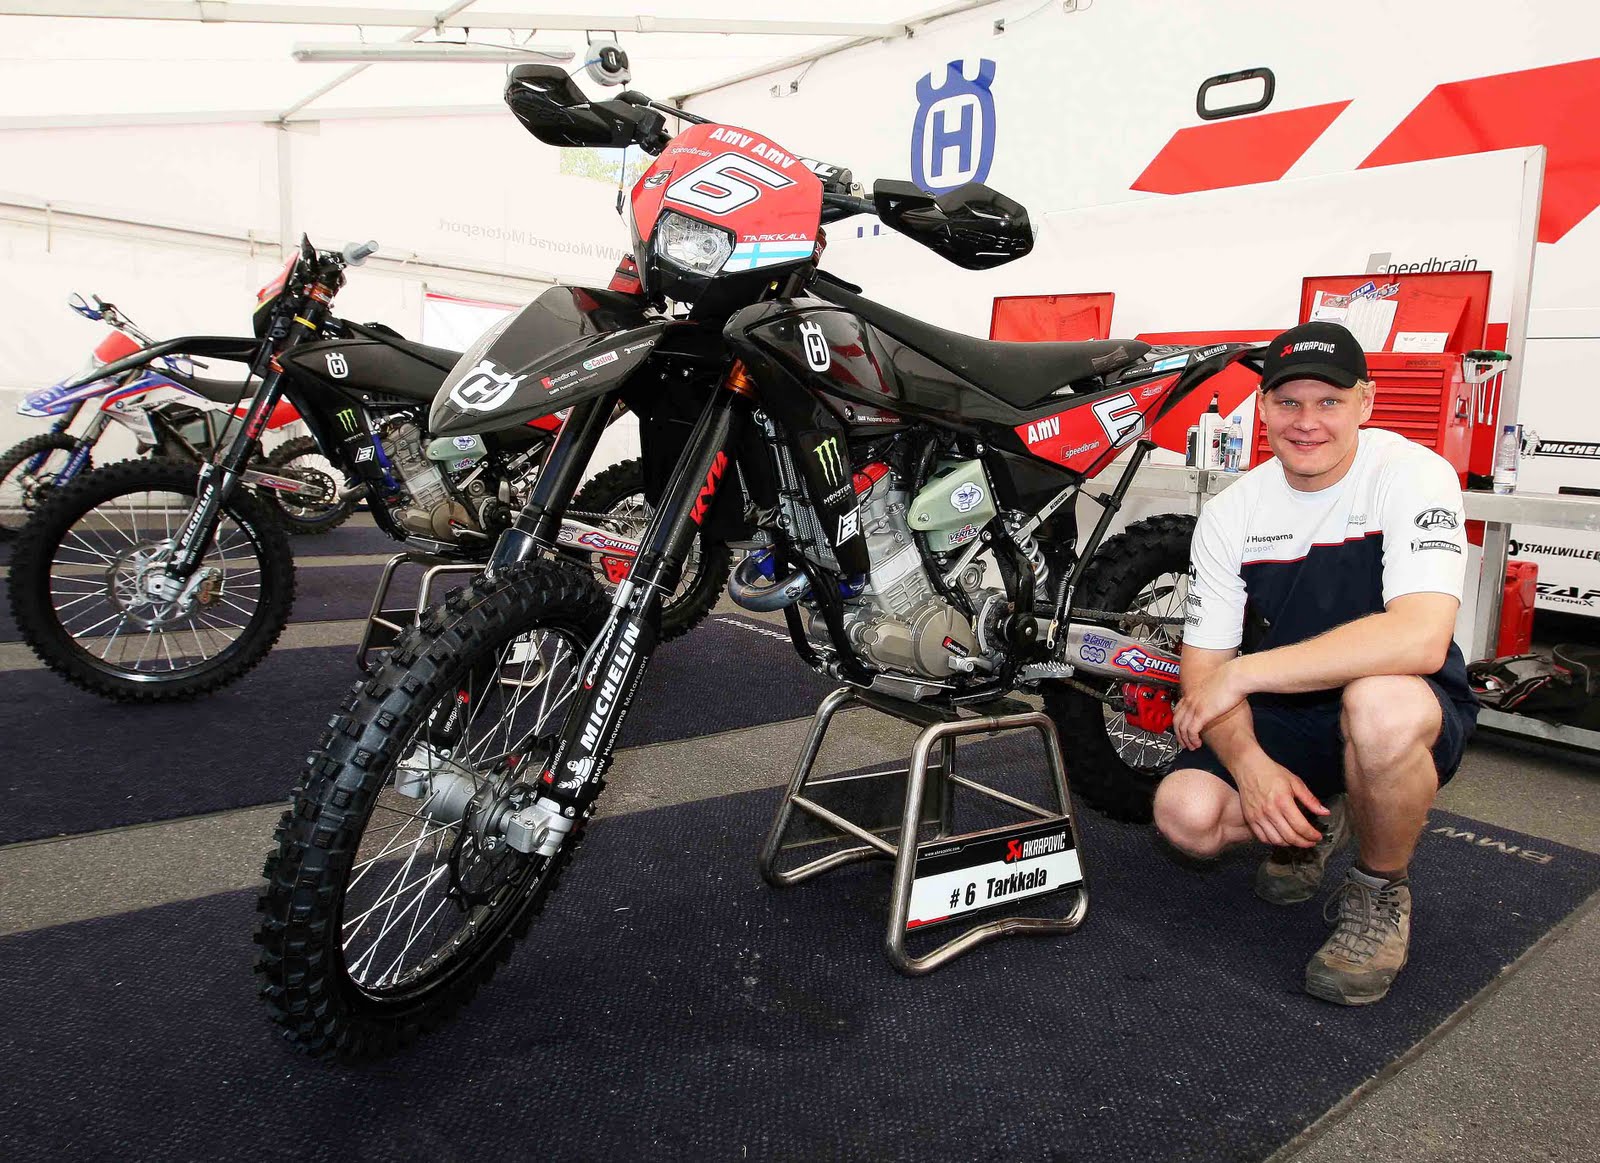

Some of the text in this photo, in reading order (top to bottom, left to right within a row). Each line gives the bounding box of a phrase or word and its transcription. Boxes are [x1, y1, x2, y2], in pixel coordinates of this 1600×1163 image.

[672, 146, 712, 157] speedbrain
[664, 152, 798, 216] 6
[743, 232, 808, 242] TARKKALA
[591, 353, 615, 368] Castrol
[547, 369, 580, 386] speedbrain
[1065, 439, 1100, 458] speedbrain
[181, 484, 215, 547] MICHELIN
[950, 527, 979, 542] VERTEX
[1252, 533, 1294, 543] Husqvarna
[1524, 544, 1594, 561] STAHLWILLE
[1537, 594, 1595, 608] TECHNIX
[580, 622, 640, 751] MICHELIN
[591, 655, 649, 784] BMW Husqvarna Motorsport
[547, 739, 567, 779] speedbrain
[1430, 826, 1555, 865] BMW
[949, 867, 1048, 909] # 6 Tarkkala
